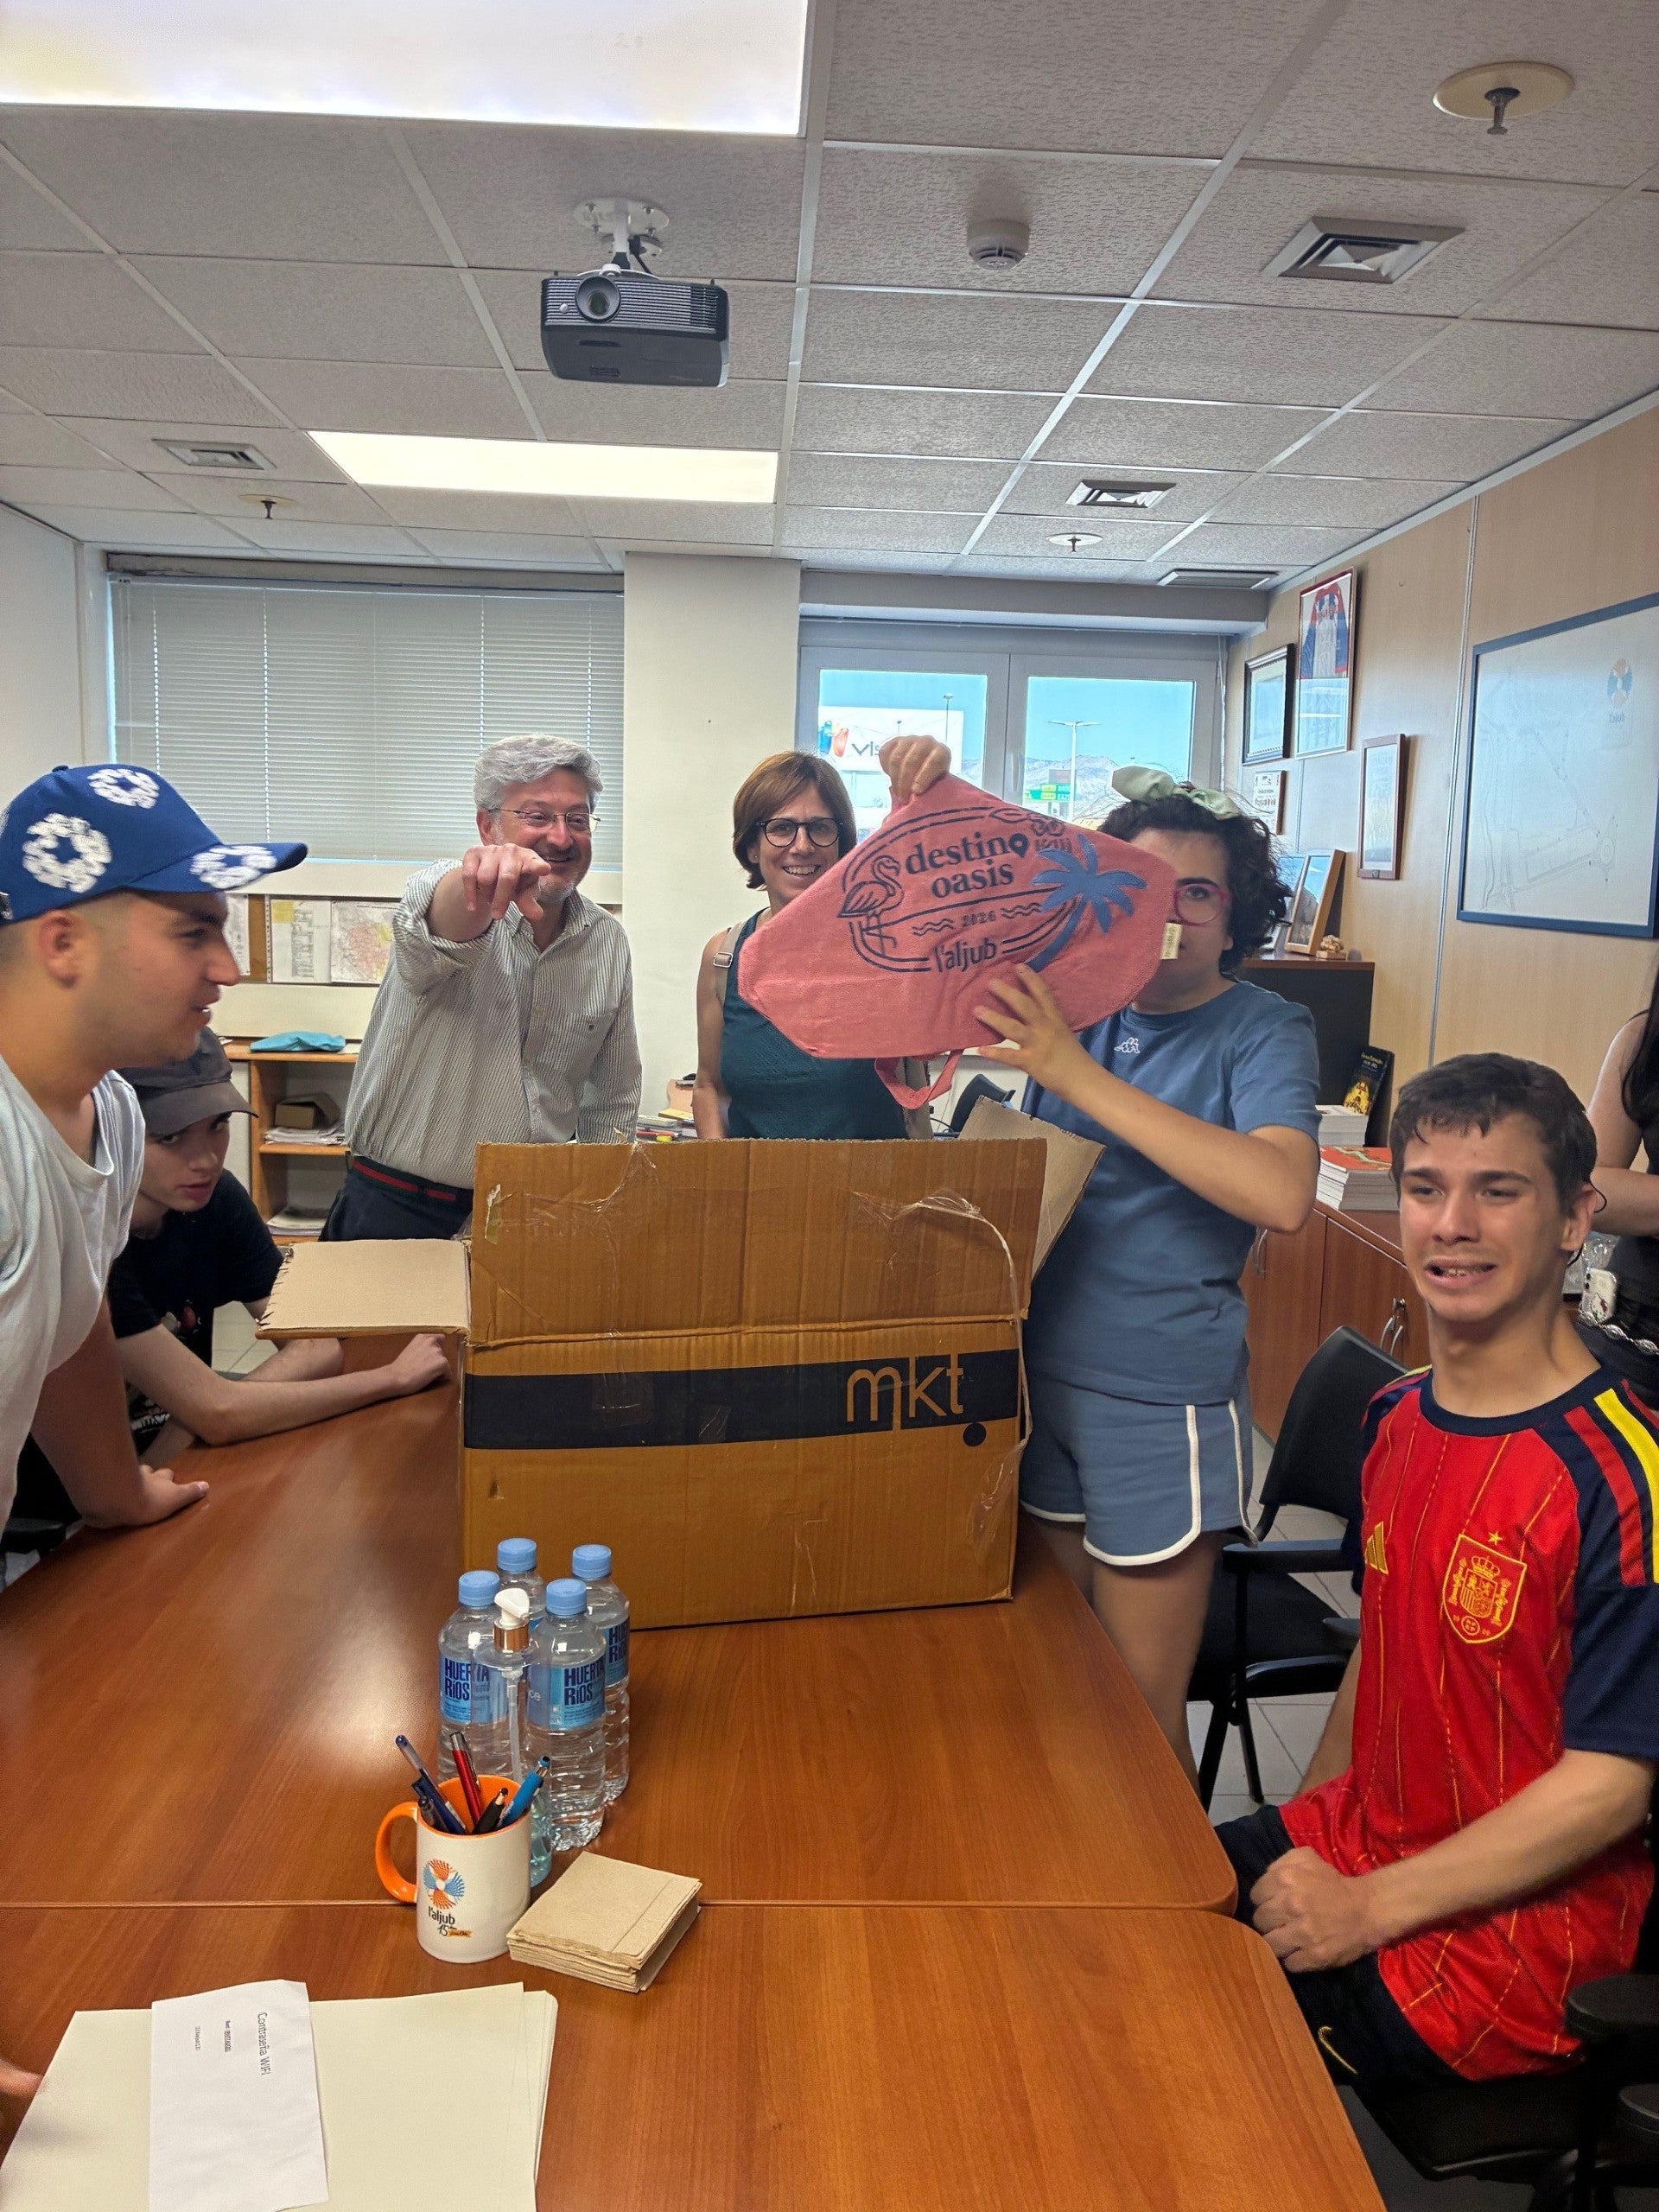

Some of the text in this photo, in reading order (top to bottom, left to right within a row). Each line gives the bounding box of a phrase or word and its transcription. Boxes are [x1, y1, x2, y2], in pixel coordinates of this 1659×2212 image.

[906, 831, 1029, 875] destino
[931, 859, 1014, 899] oasis
[428, 1905, 455, 1925] l'aljub
